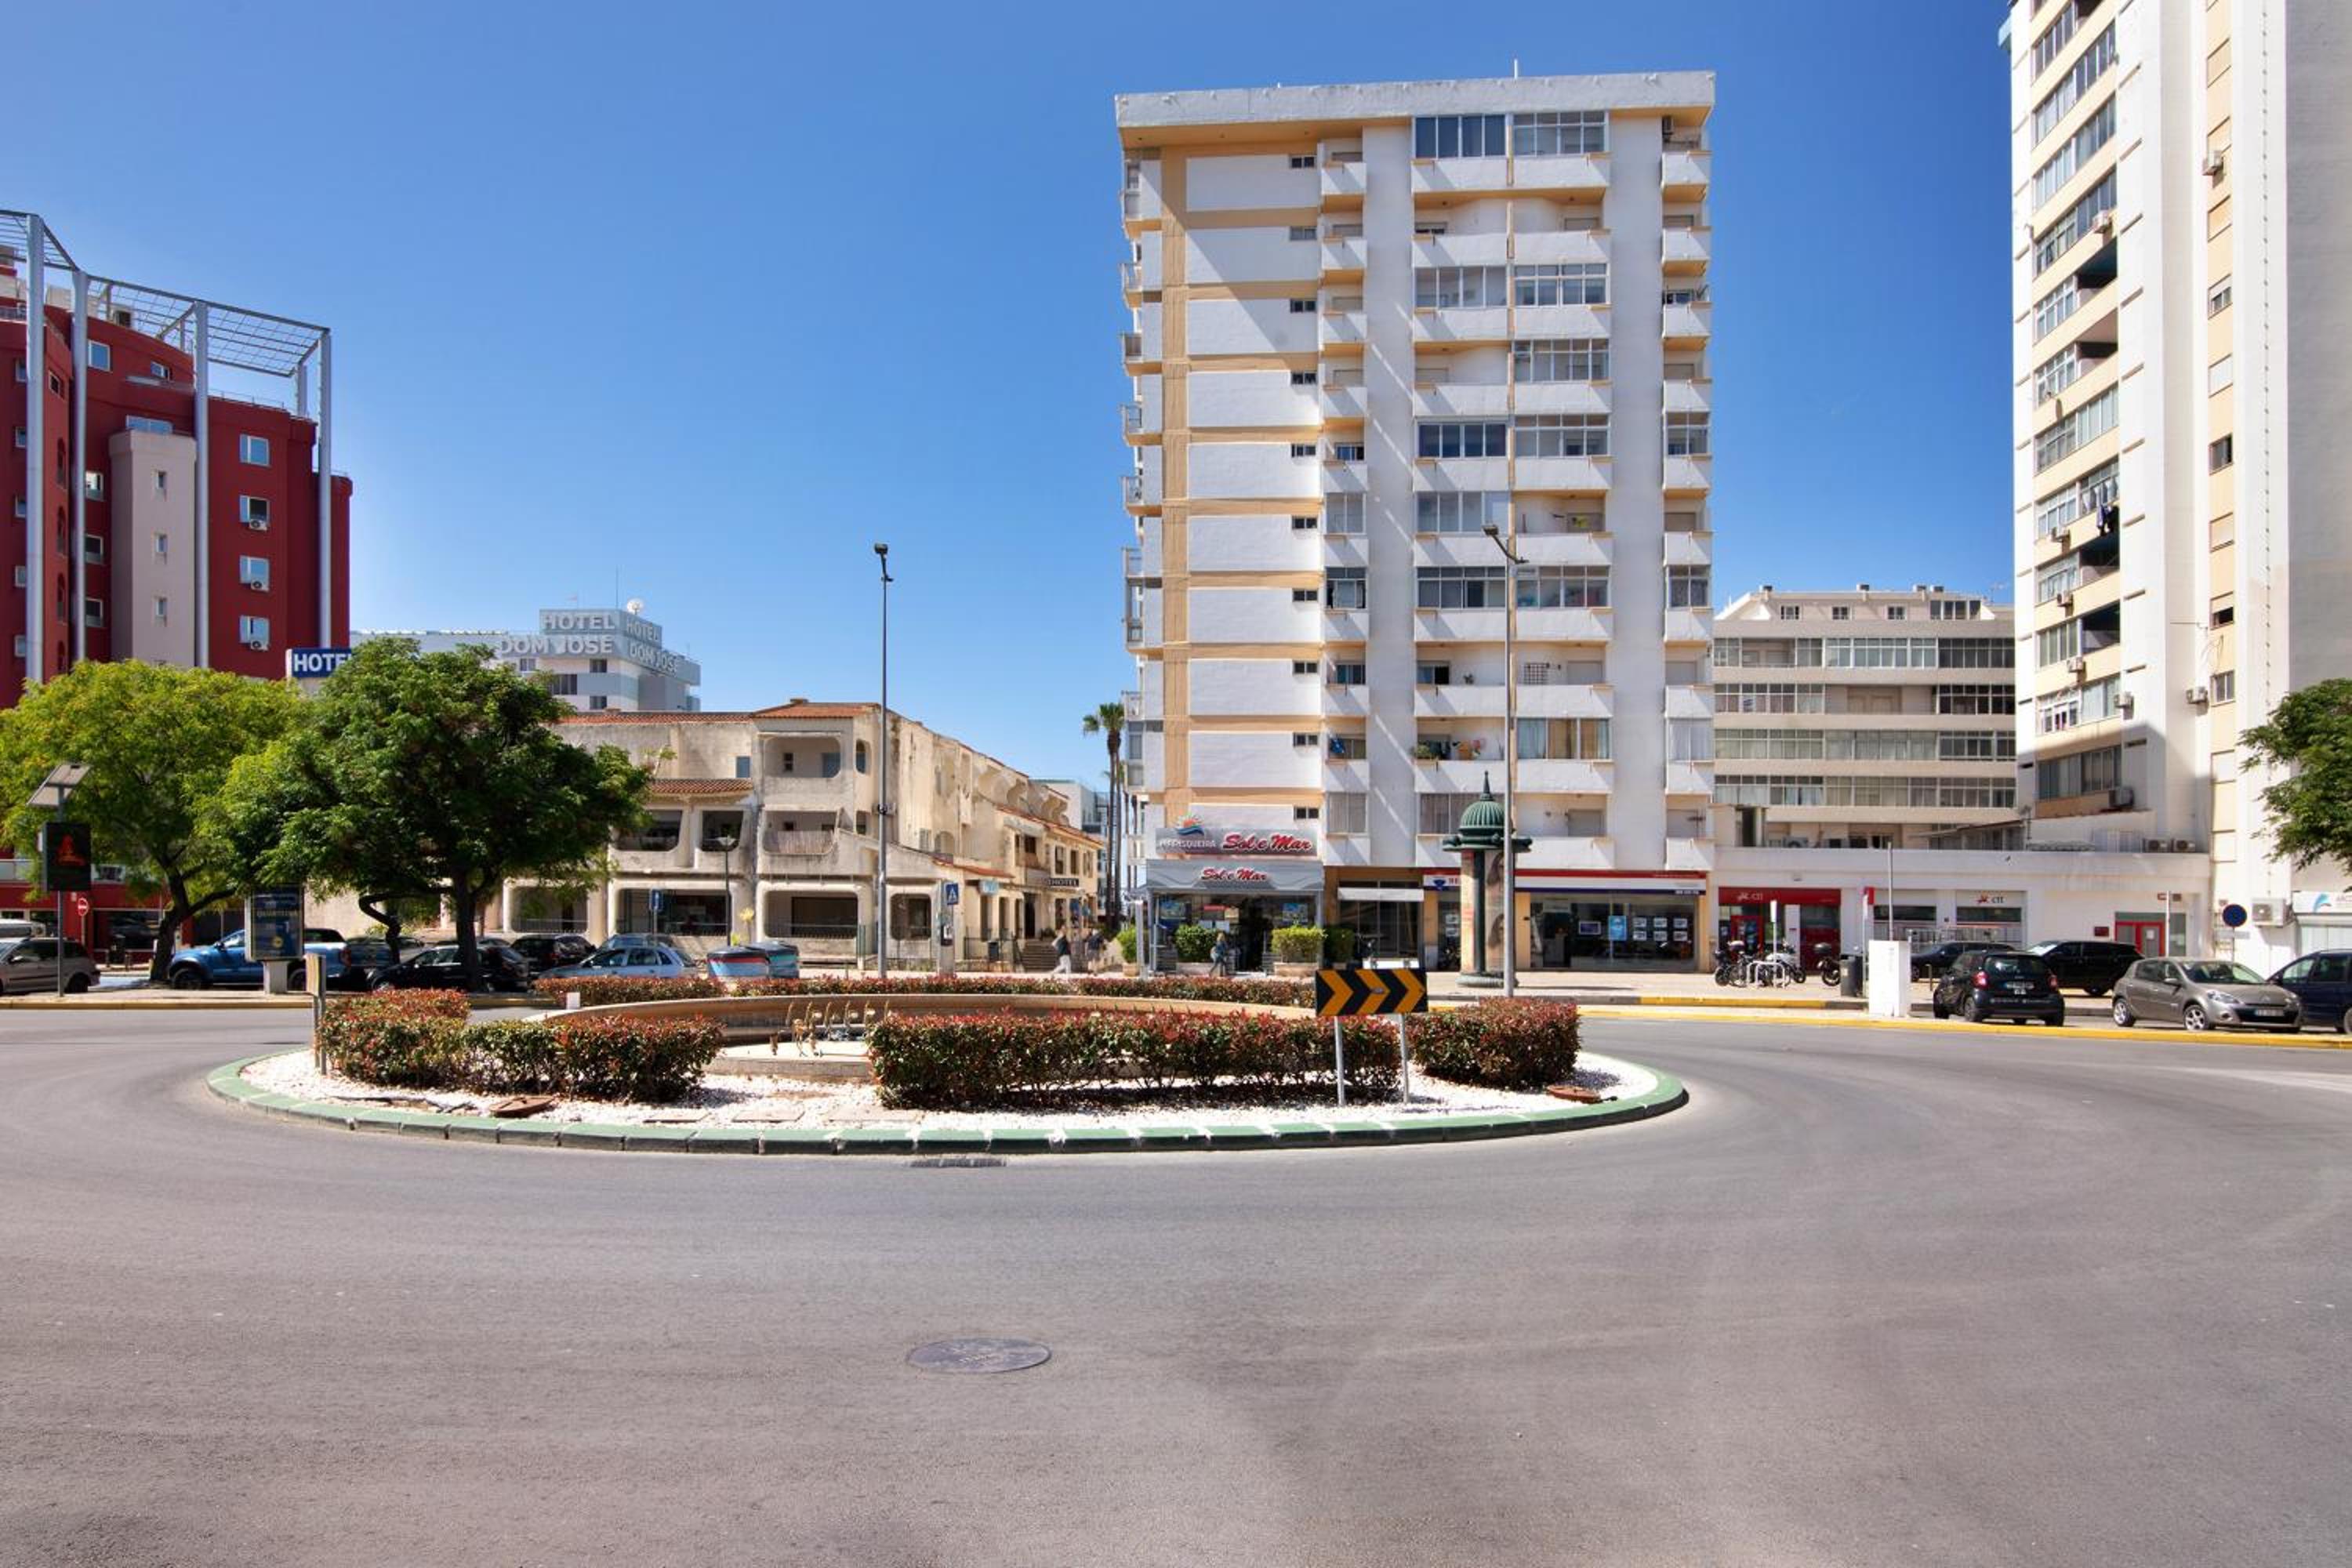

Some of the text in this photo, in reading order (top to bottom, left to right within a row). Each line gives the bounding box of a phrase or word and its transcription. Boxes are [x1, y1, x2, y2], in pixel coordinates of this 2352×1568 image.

[544, 613, 615, 630] HOTEL
[626, 621, 659, 643] HOTEL
[500, 637, 549, 654] DOM
[1222, 832, 1255, 851] Sol
[1270, 833, 1312, 851] Mar
[1201, 868, 1225, 880] Sol
[1236, 869, 1267, 880] Mar
